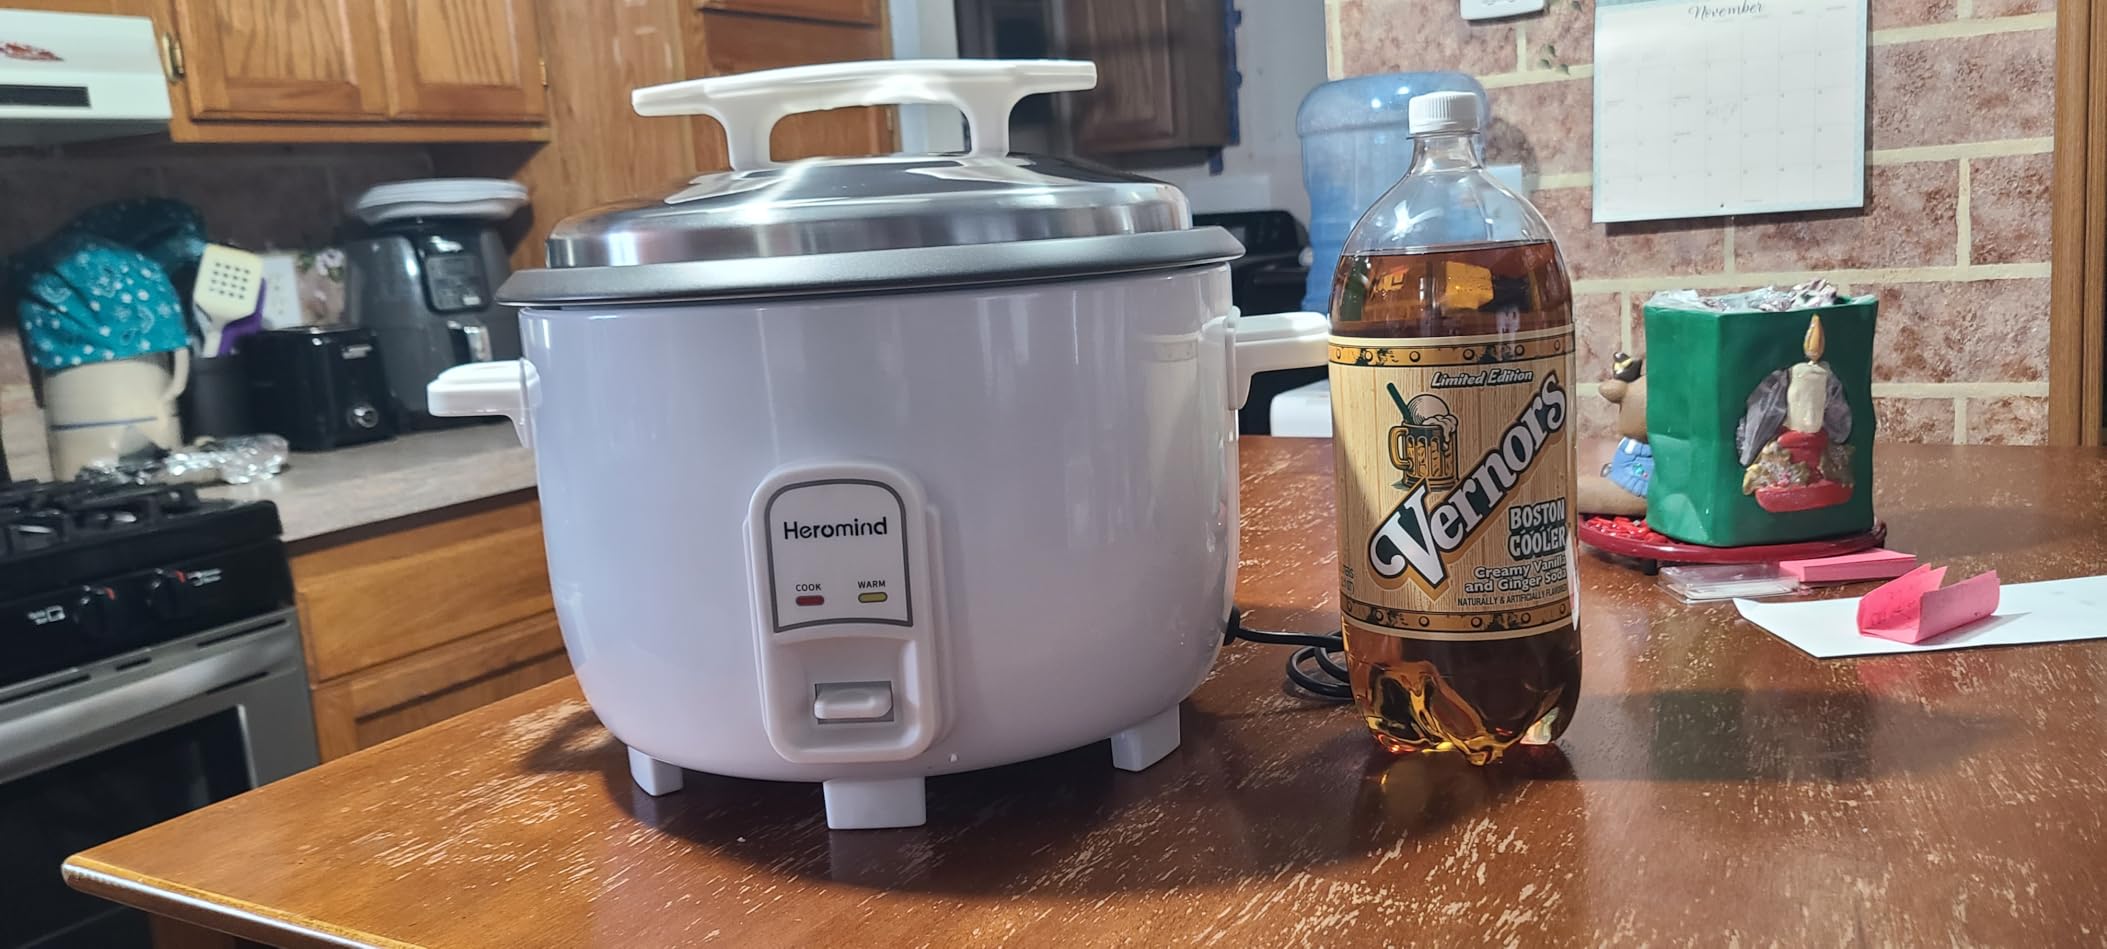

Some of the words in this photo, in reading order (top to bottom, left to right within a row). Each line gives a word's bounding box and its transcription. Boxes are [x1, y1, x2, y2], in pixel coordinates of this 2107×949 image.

[1688, 0, 1763, 22] November
[1431, 371, 1486, 388] Limited
[1487, 368, 1533, 386] Edition
[1370, 373, 1567, 587] Vernors
[1509, 498, 1566, 530] BOSTON
[783, 516, 888, 540] Heromind
[1509, 526, 1567, 557] COOLER
[1474, 564, 1530, 579] Creamy
[1533, 554, 1567, 573] Vanilla
[795, 583, 822, 592] COOK
[857, 580, 886, 589] WARM
[1465, 580, 1494, 593] and
[1498, 576, 1542, 592] Ginger
[1543, 567, 1567, 584] Soda
[1457, 596, 1498, 606] NATURALLY
[1500, 595, 1505, 604] &
[1506, 590, 1545, 604] ARTIFICIALLY
